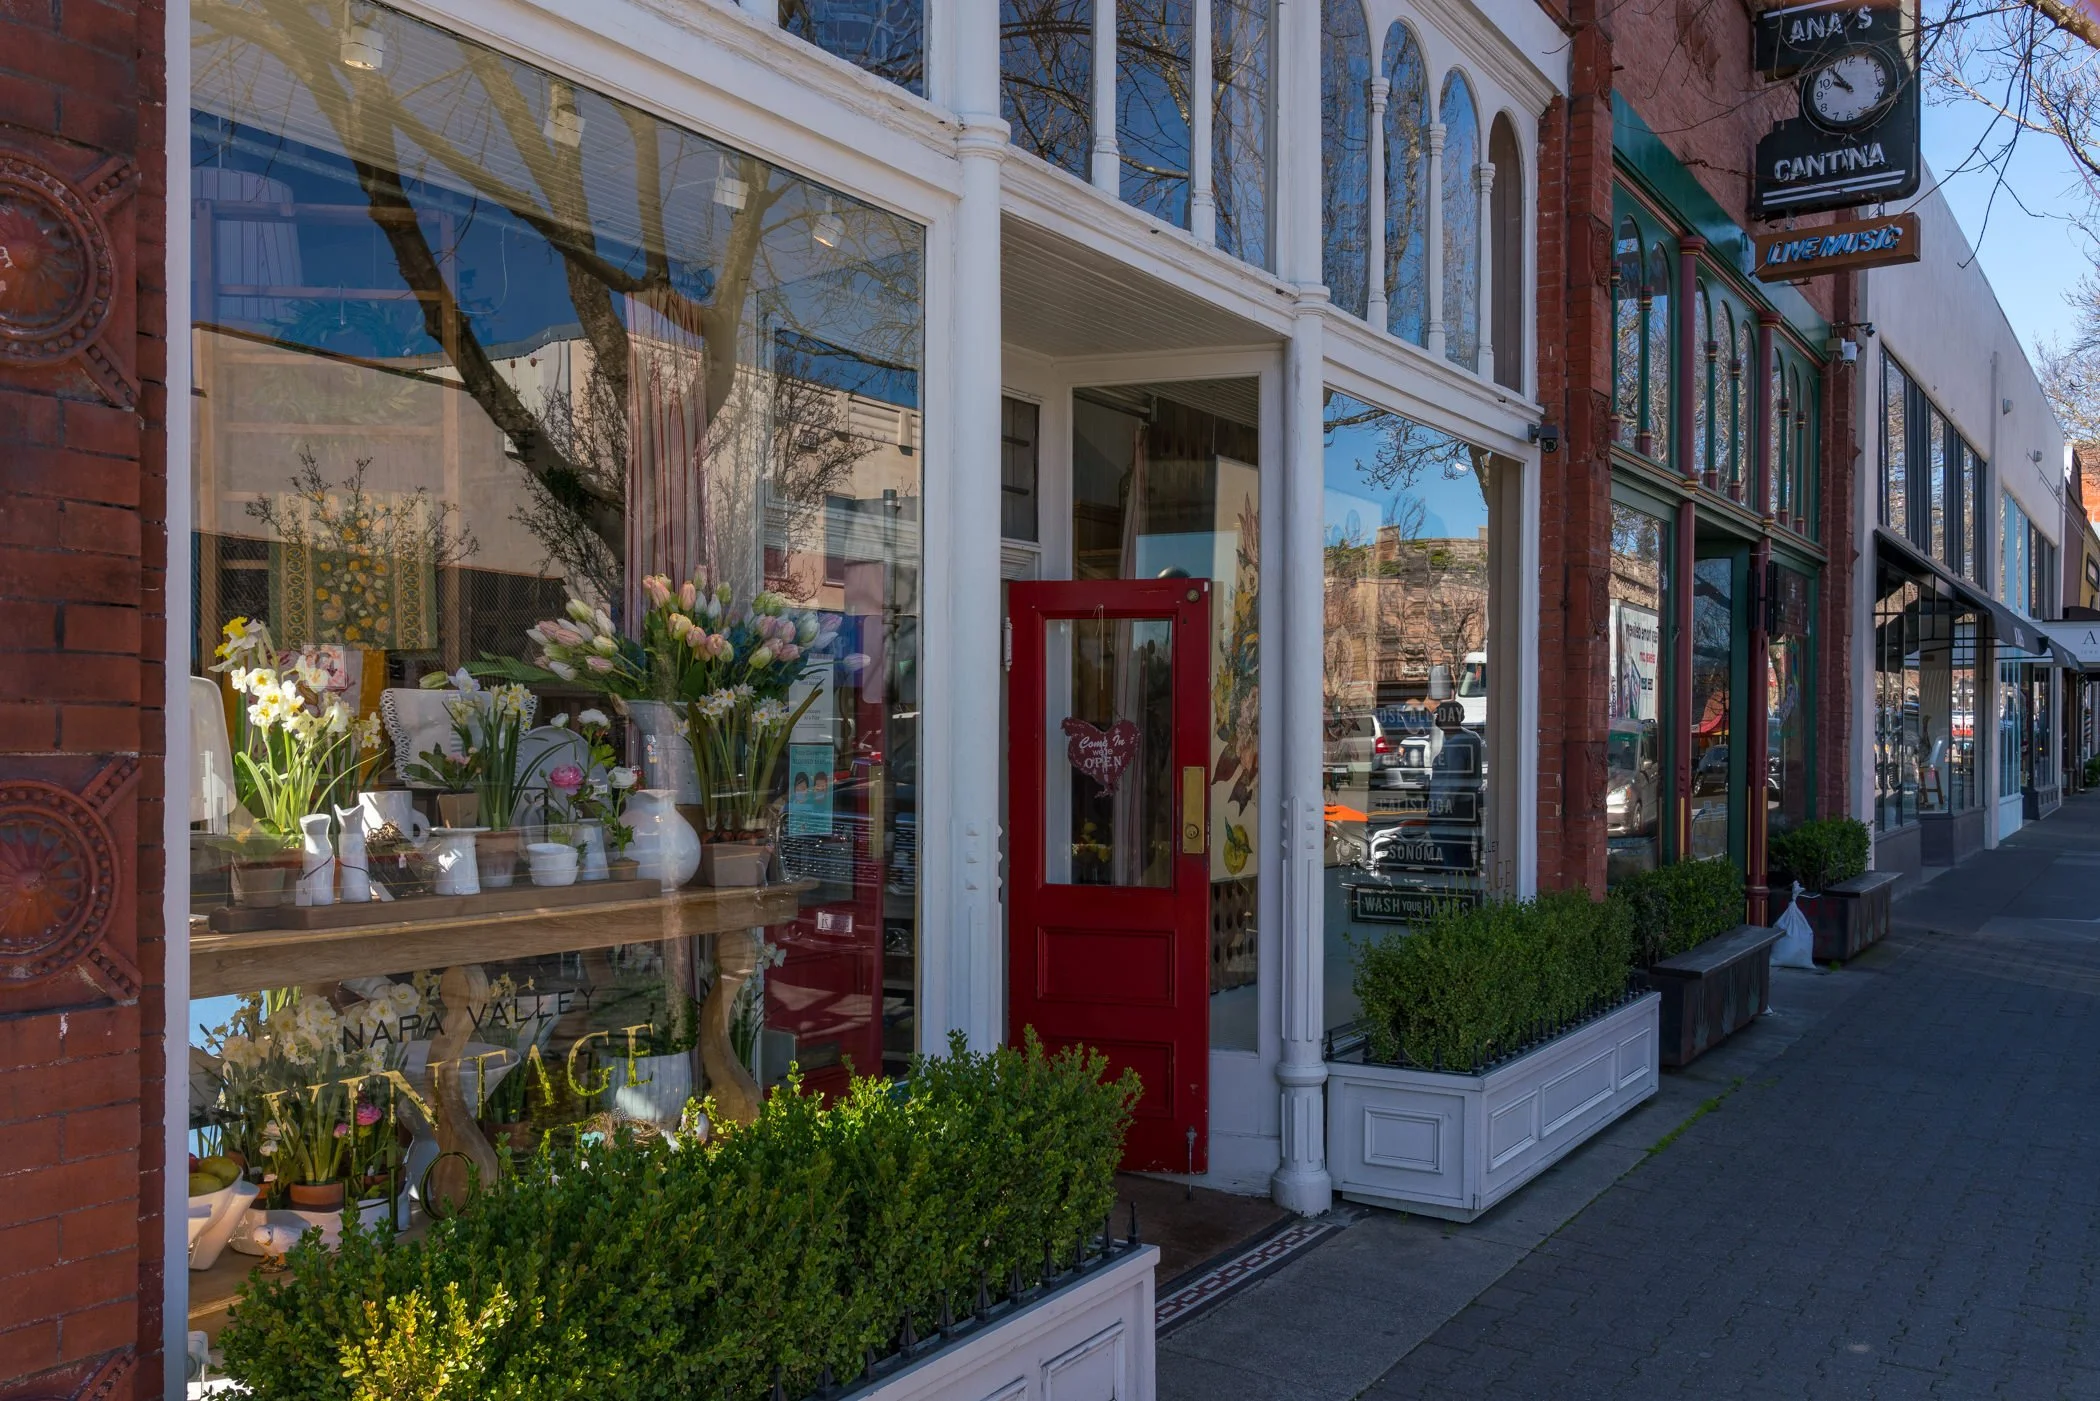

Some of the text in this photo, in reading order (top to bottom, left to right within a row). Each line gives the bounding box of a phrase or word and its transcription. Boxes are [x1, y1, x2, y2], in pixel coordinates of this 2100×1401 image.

[1774, 142, 1886, 183] CANTINA
[1766, 224, 1904, 266] LIVE MUSIC
[1439, 707, 1465, 723] DAY
[1079, 734, 1125, 749] Come In
[1084, 756, 1122, 769] OPEN
[1389, 844, 1444, 861] SONOMA
[1365, 897, 1400, 913] WASH
[1402, 901, 1422, 912] YOUR
[342, 985, 599, 1052] NAPA VALLEY
[262, 1022, 655, 1158] VINTAGE
